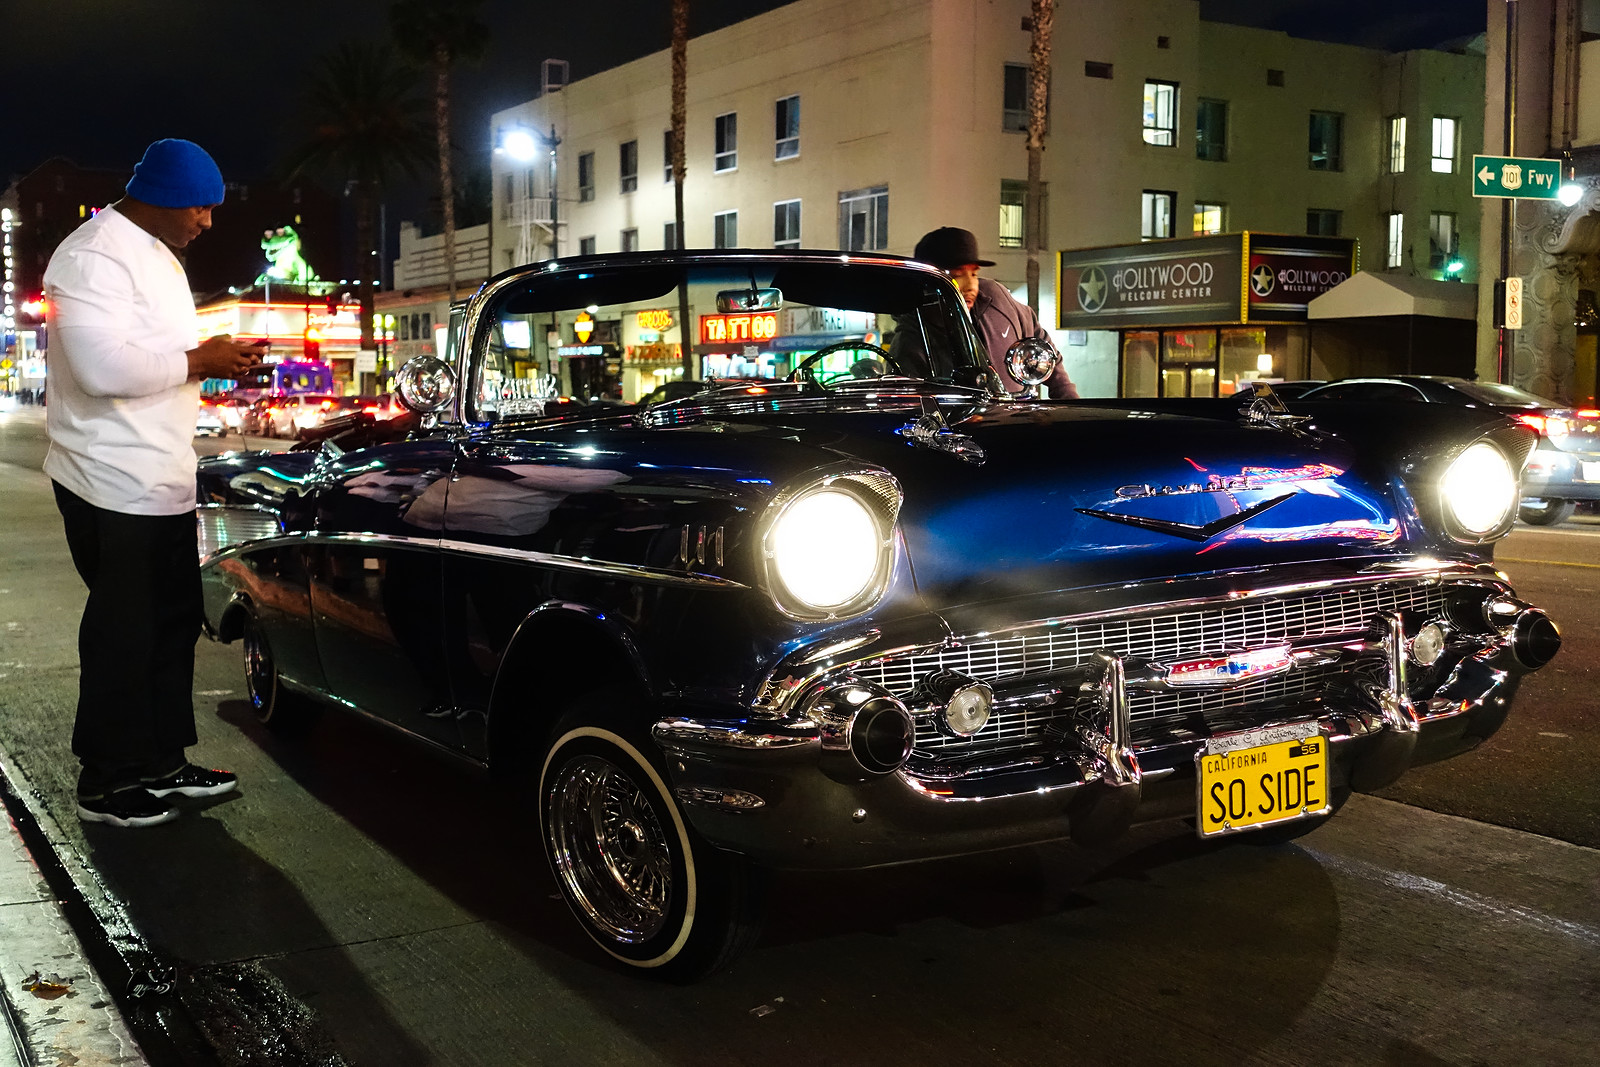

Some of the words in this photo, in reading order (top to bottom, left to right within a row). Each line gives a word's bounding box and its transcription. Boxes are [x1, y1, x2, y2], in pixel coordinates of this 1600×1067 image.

[1505, 171, 1518, 183] 101
[1528, 169, 1553, 189] Fwy
[1112, 262, 1214, 292] HOLLYWOOD
[1283, 284, 1316, 292] WELCOME
[1120, 289, 1166, 301] WELCOME
[1171, 287, 1211, 299] CENTER
[705, 315, 777, 340] TATTOO
[1114, 476, 1259, 498] Chevrolet
[1207, 752, 1268, 773] CALIFORNIA
[1301, 744, 1317, 755] 56
